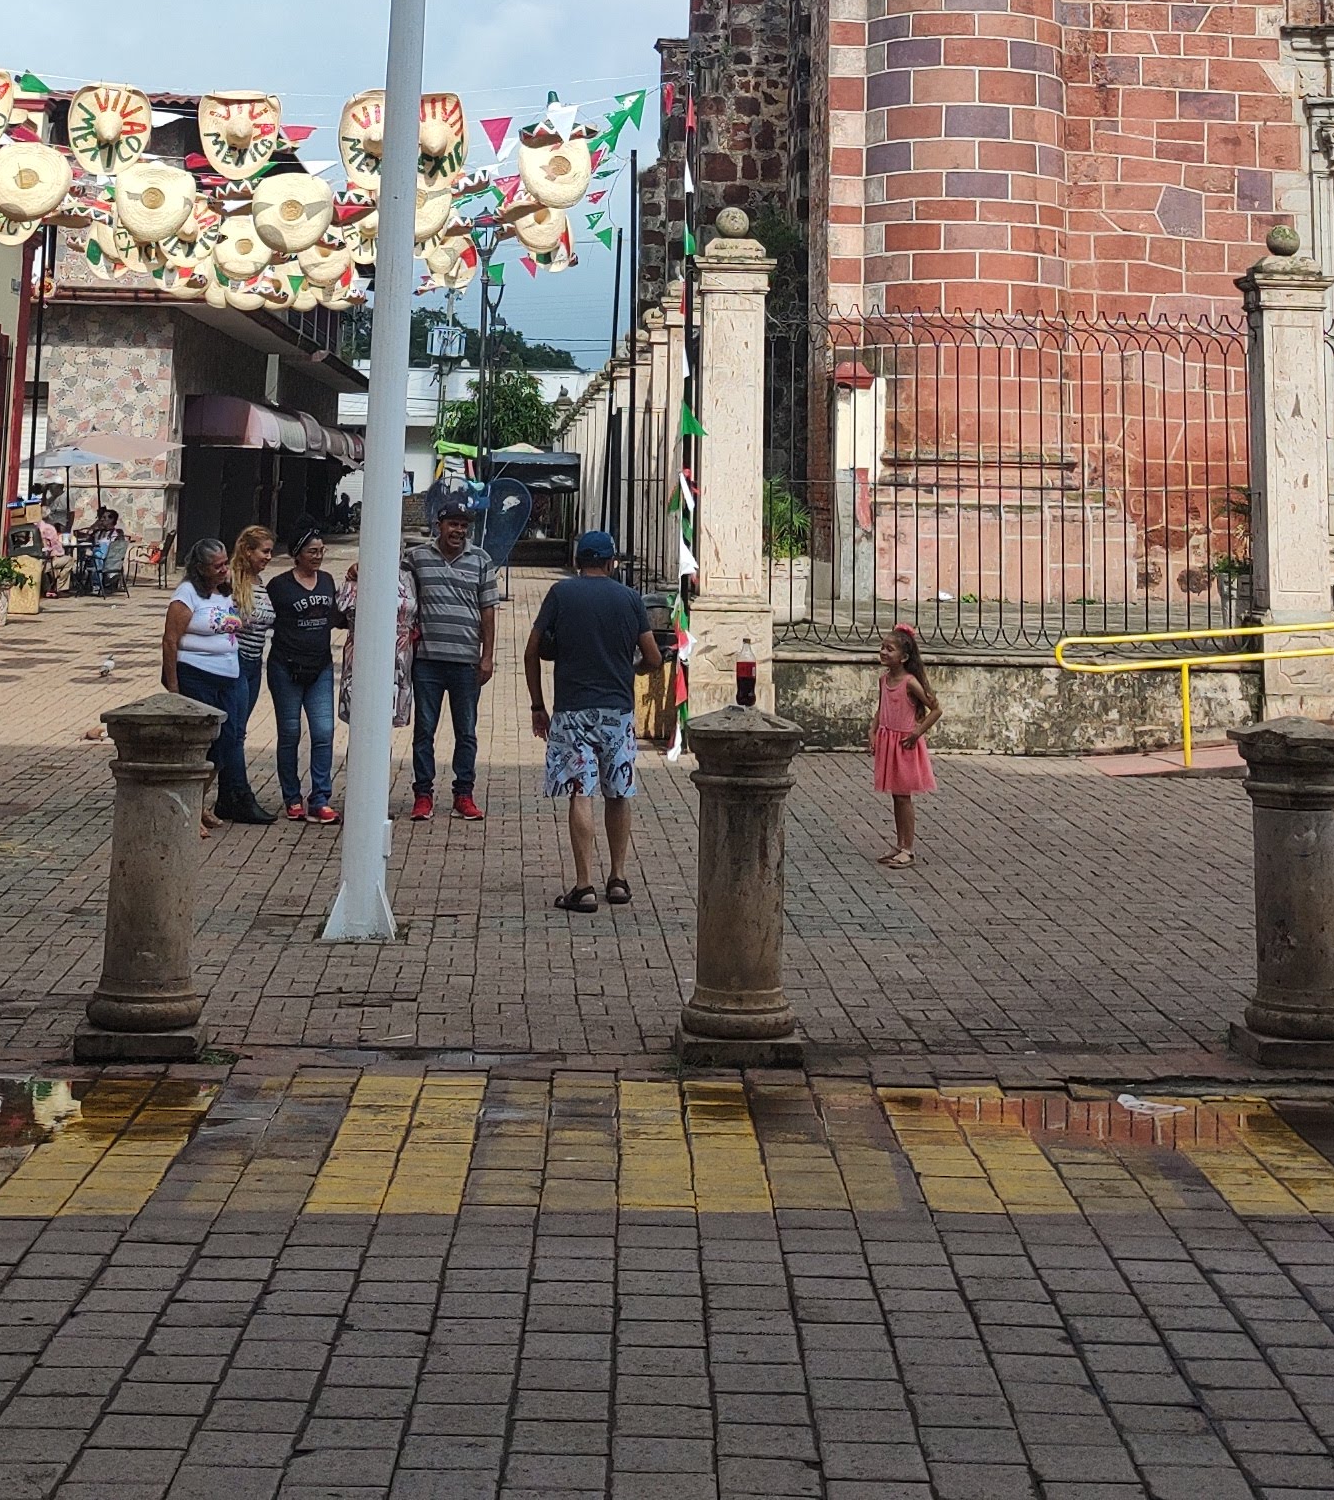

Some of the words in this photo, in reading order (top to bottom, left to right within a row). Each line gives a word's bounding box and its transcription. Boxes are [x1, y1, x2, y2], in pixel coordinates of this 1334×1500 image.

[94, 88, 147, 135] VIVA
[209, 99, 276, 141] VIVA
[70, 102, 142, 168] MEXICO
[203, 132, 274, 167] MEXICO
[293, 598, 308, 612] US
[309, 595, 333, 607] OPEN
